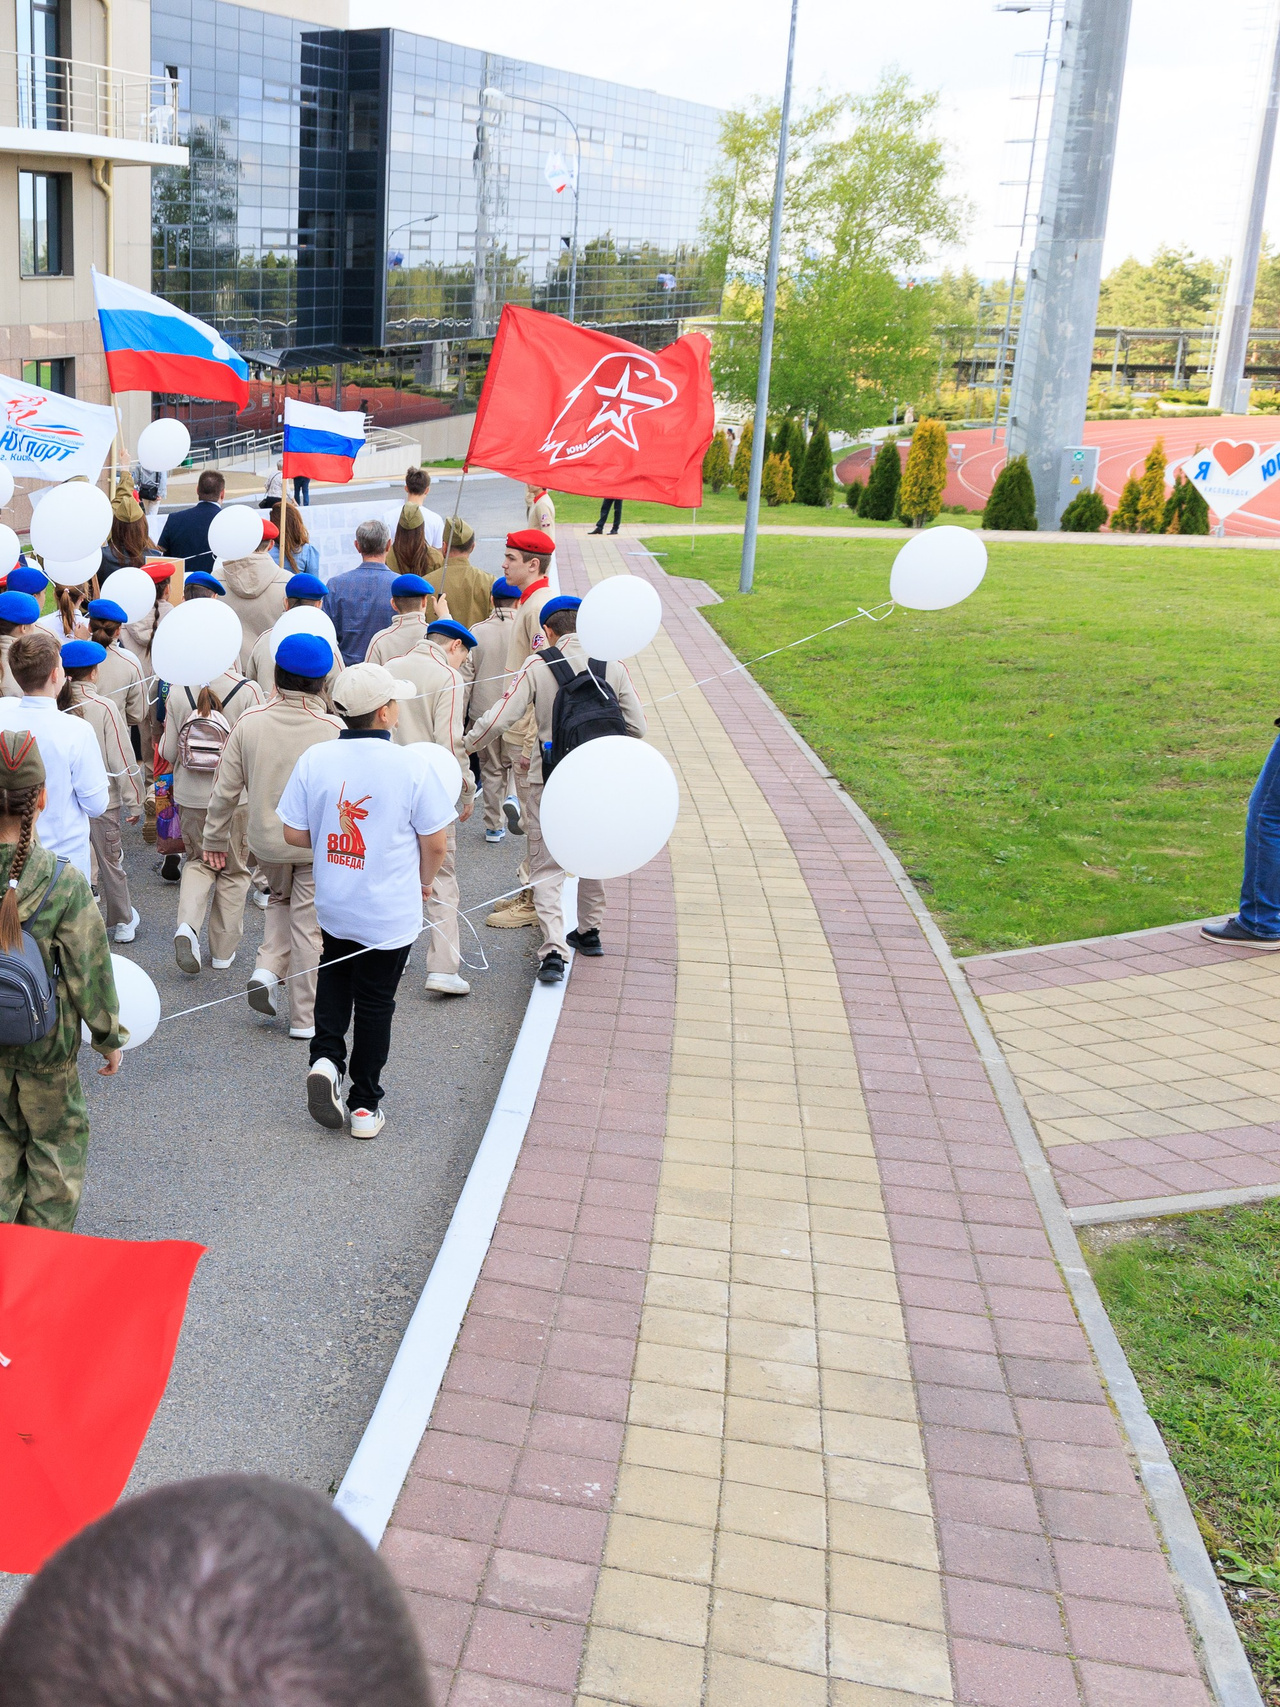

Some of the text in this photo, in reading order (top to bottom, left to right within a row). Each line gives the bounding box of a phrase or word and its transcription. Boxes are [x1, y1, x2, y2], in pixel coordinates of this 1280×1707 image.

[1194, 461, 1211, 480] Я
[327, 833, 350, 852] 80
[327, 853, 365, 870] ПОБЕДА!
